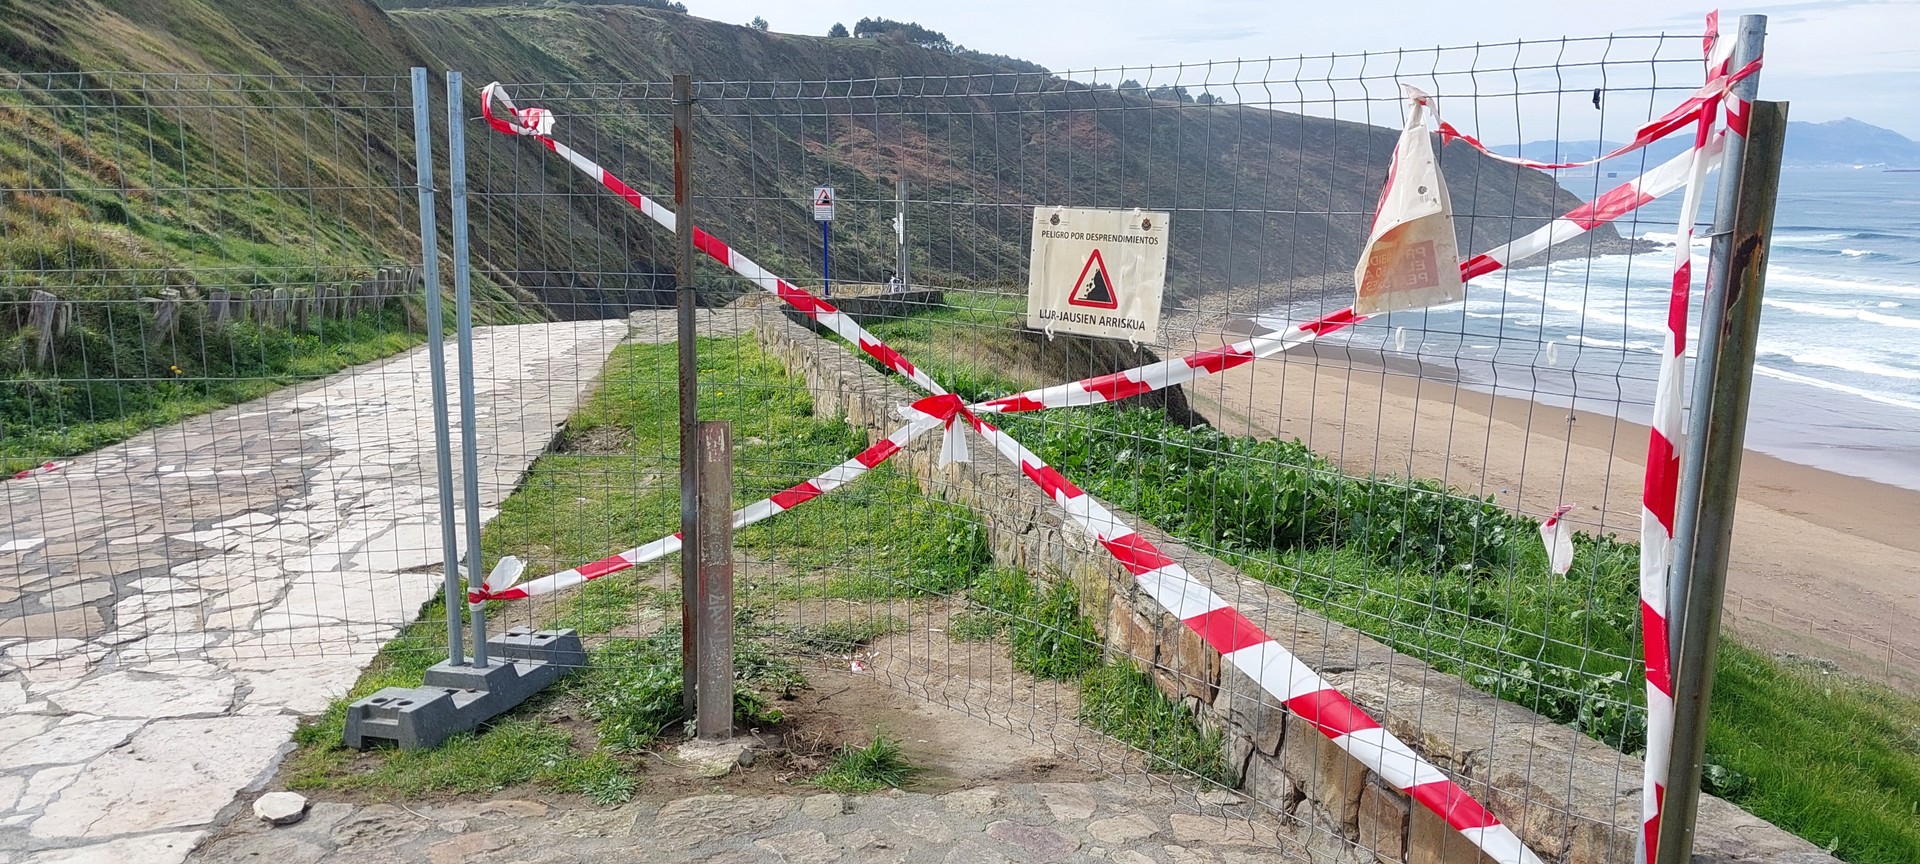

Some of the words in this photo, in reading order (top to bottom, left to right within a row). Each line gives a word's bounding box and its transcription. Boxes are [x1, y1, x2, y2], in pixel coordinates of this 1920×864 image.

[1041, 230, 1069, 240] PELIGRO
[1071, 232, 1084, 241] POR
[1086, 233, 1159, 245] DESPRENDIMIENTOS
[1039, 309, 1097, 325] LUR-JAUSIEN
[1099, 315, 1146, 331] ARRISKUA
